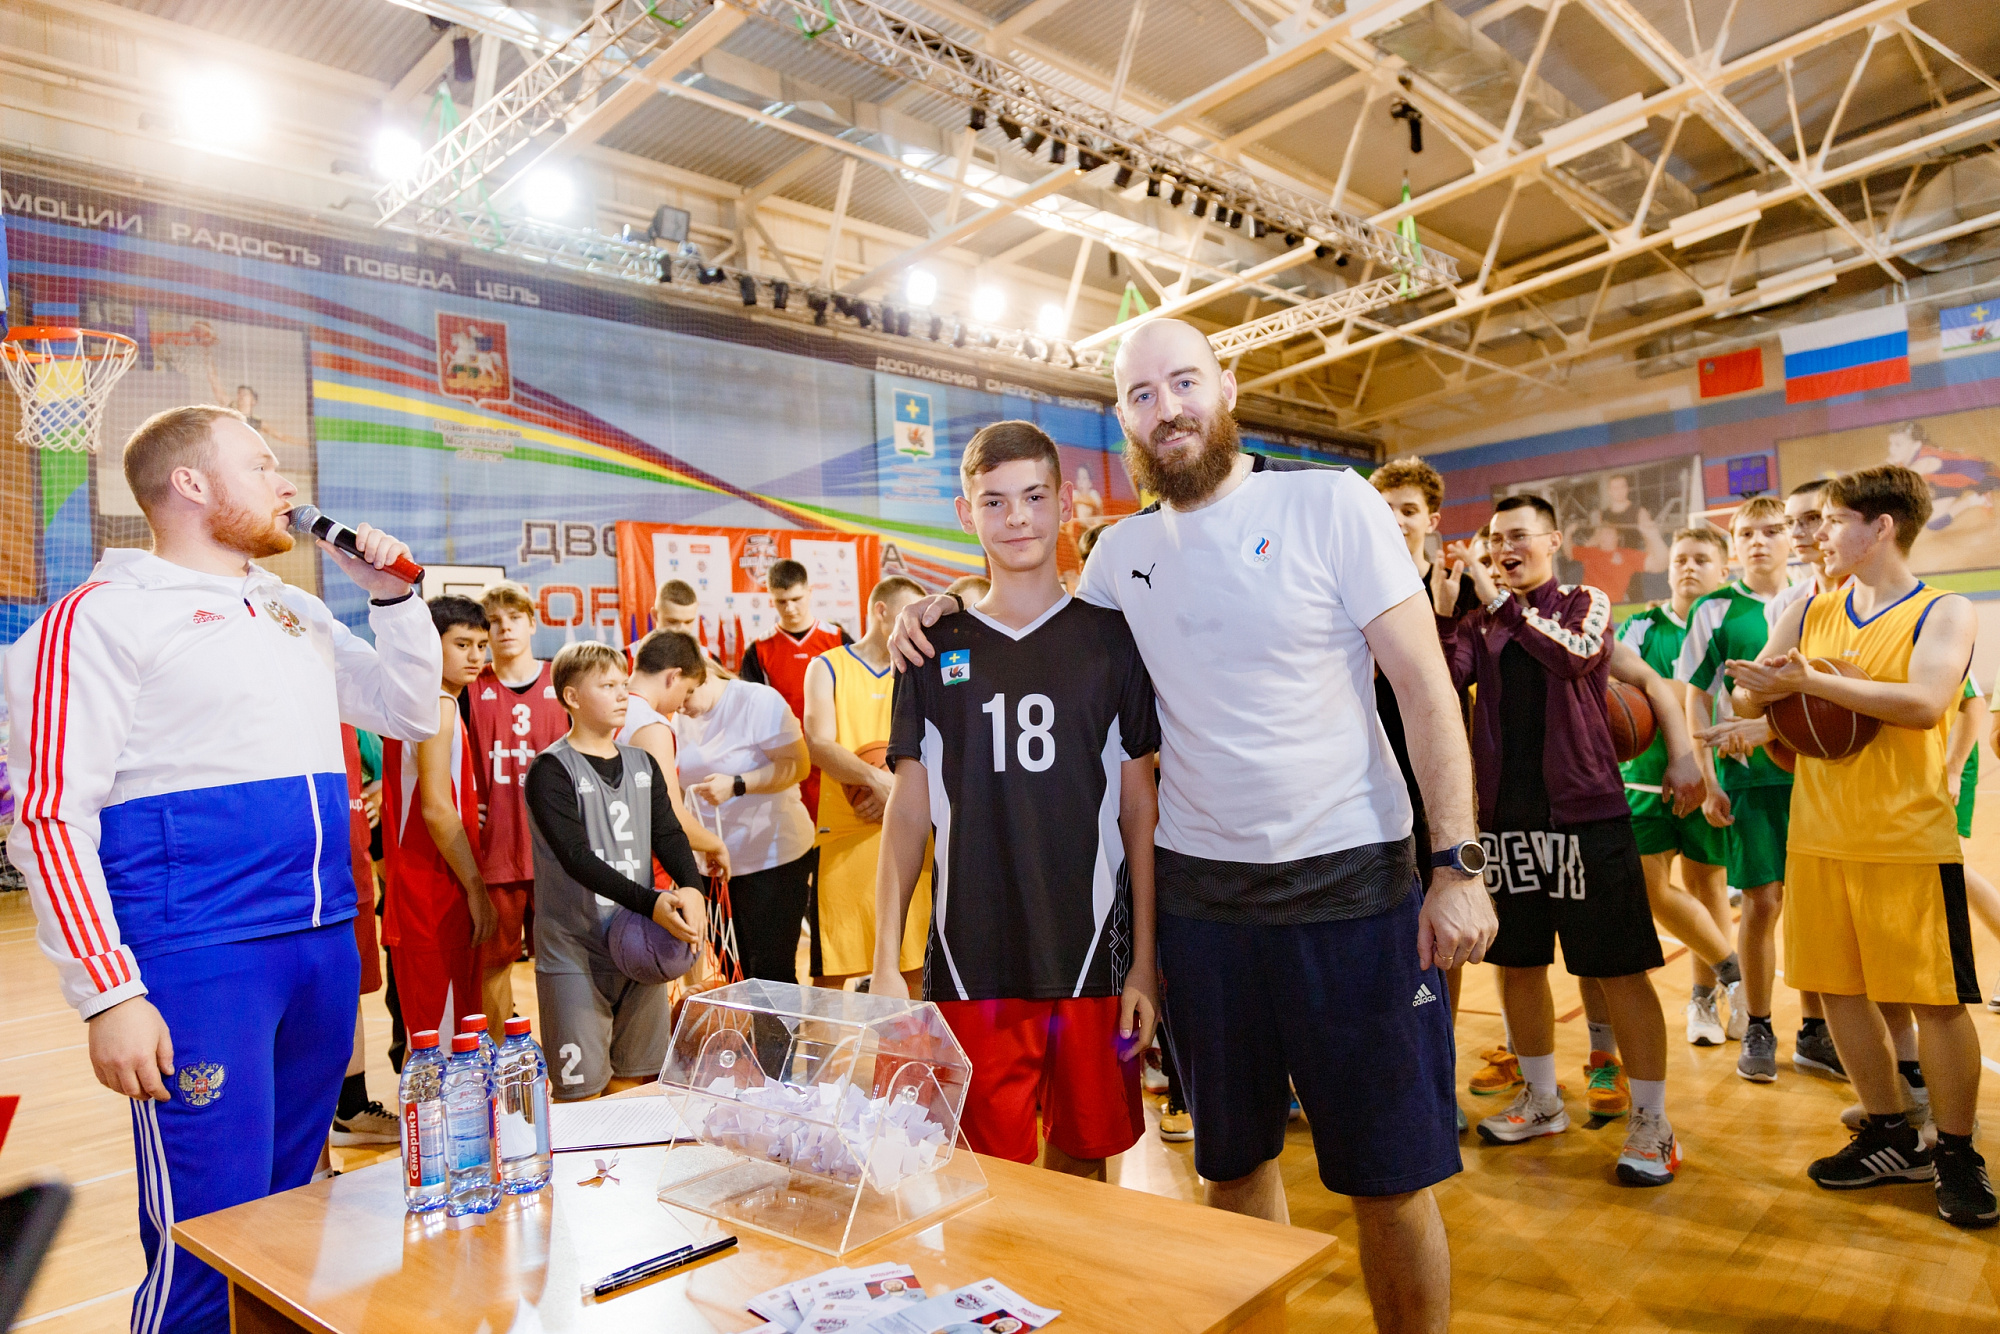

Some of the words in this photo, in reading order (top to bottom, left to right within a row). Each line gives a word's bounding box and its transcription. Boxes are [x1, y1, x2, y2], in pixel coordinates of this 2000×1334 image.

[170, 222, 322, 267] РАДОСТЬ
[344, 255, 456, 291] ПОБЕДА
[475, 279, 540, 305] ЦЕЛЬ
[876, 356, 978, 388] ДОСТИЖЕНИЯ
[985, 378, 1053, 404] СМЕЛОСТЬ
[434, 420, 522, 438] Правительство
[445, 434, 513, 450] Московской
[193, 614, 226, 624] adidas
[511, 703, 532, 736] 3
[982, 692, 1056, 773] 18
[609, 800, 634, 841] 2
[1412, 994, 1437, 1007] adidas
[559, 1042, 585, 1086] 2
[408, 1110, 419, 1180] Семерикъ
